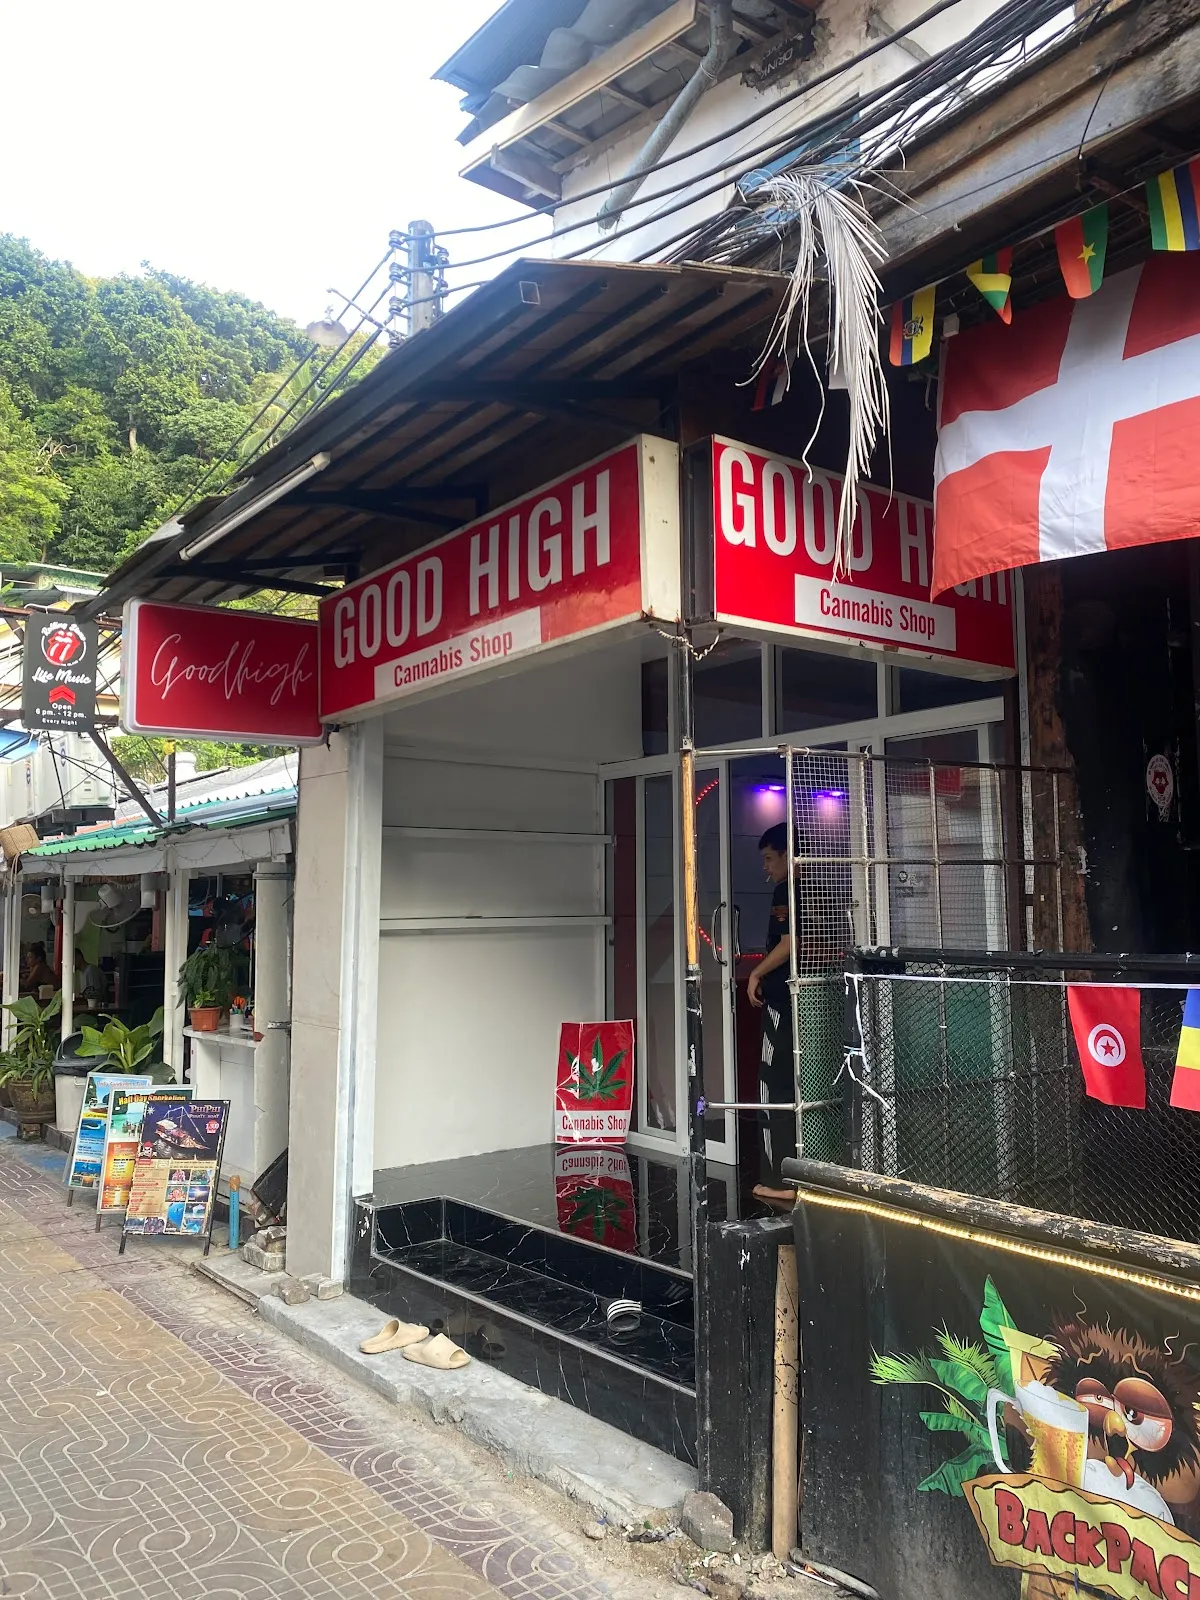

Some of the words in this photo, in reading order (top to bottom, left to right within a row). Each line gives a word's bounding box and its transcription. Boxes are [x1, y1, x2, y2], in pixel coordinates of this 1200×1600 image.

[719, 446, 873, 572] GOOD
[333, 556, 443, 669] GOOD
[469, 468, 611, 617] HIGH
[820, 588, 893, 628] Cannabis
[899, 605, 935, 640] Shop
[55, 668, 92, 684] Music
[394, 647, 462, 688] Cannabis
[469, 630, 513, 663] Shop
[52, 702, 72, 710] Open
[562, 1115, 604, 1131] Cannabis
[994, 1488, 1200, 1600] BACKPAC
